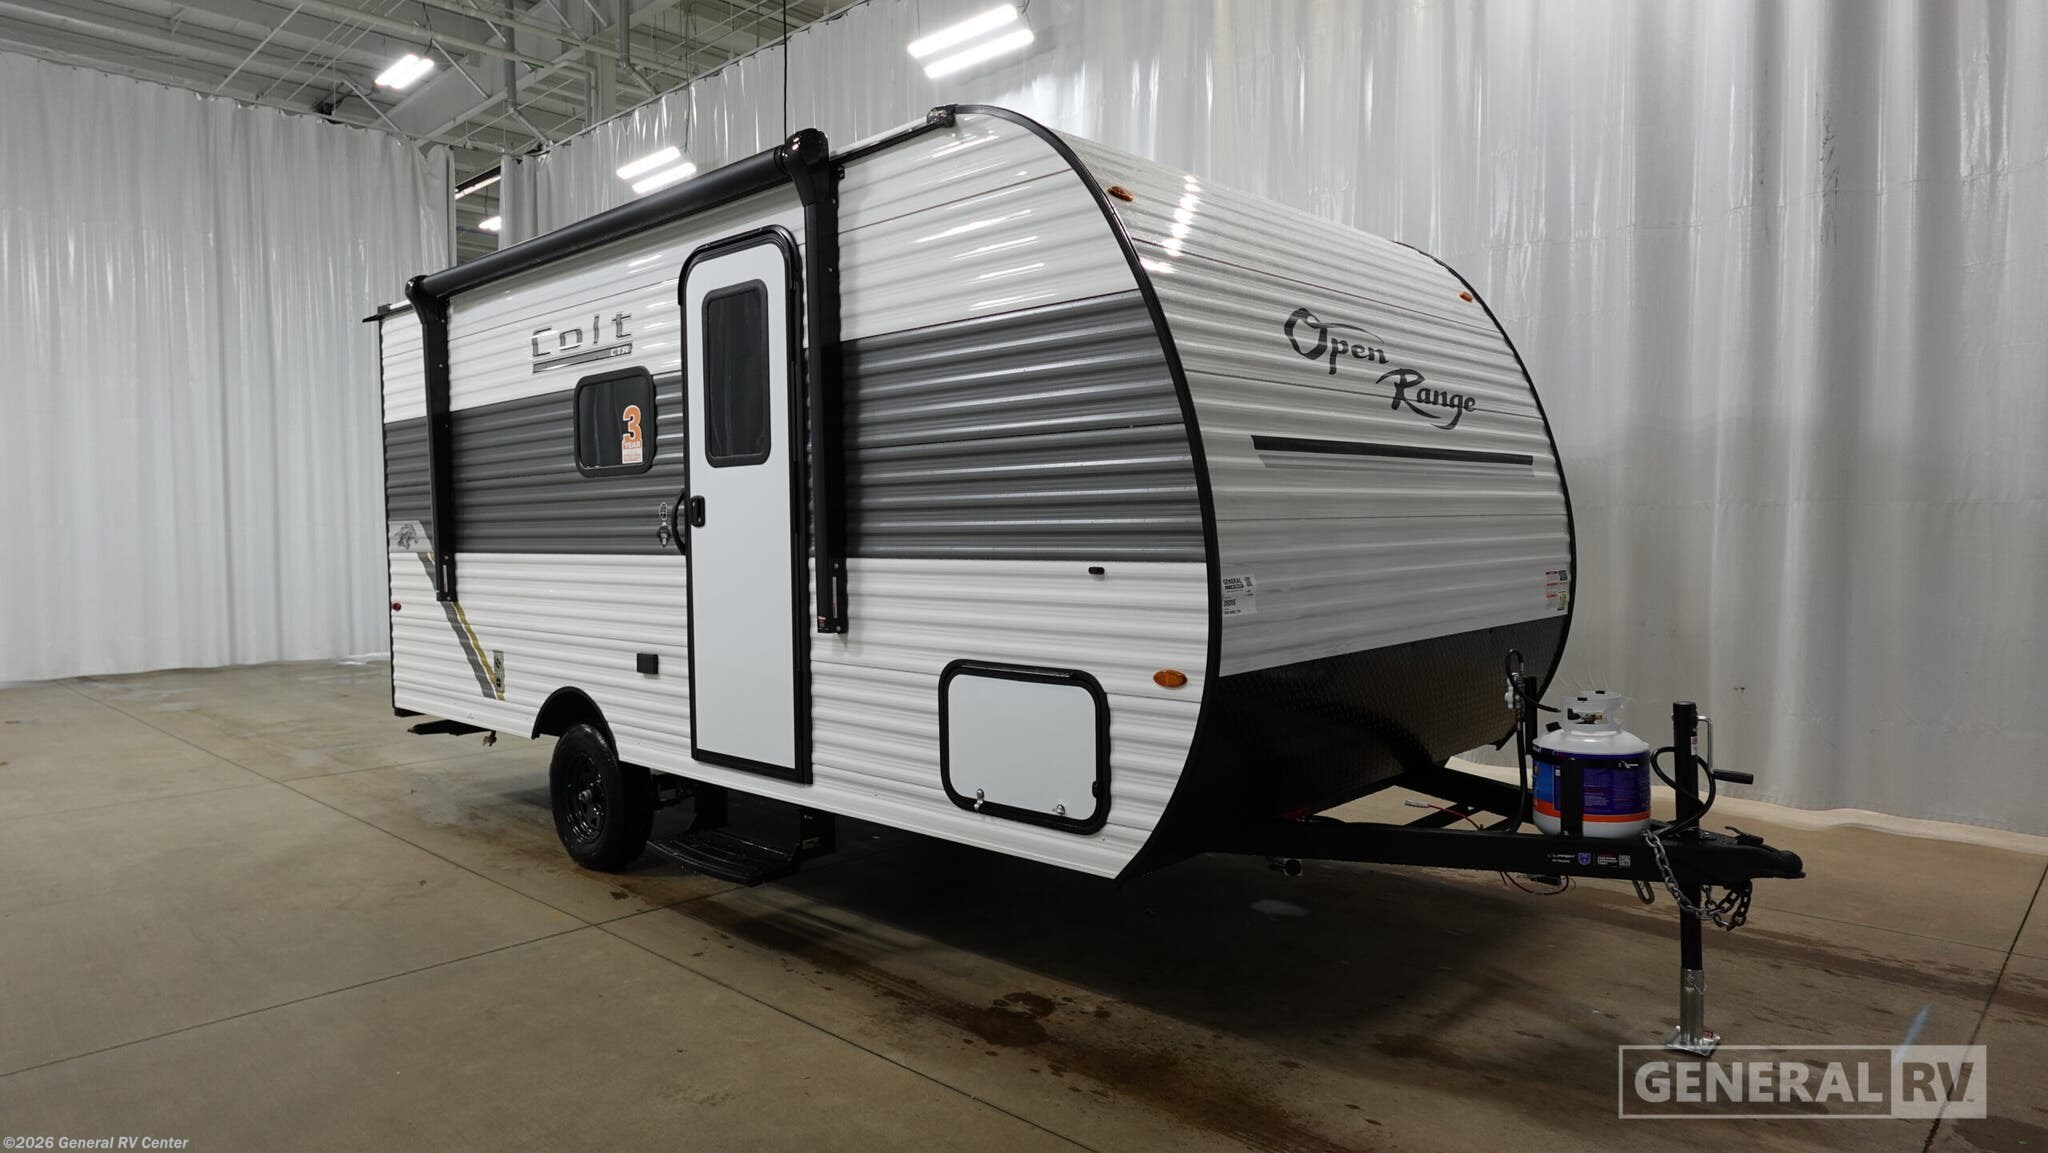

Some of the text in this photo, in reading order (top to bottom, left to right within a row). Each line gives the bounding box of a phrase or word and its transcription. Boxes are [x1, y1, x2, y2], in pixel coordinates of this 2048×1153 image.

[531, 313, 632, 357] Colt
[1284, 307, 1389, 375] Open
[623, 405, 642, 443] 3
[1375, 368, 1476, 430] Range
